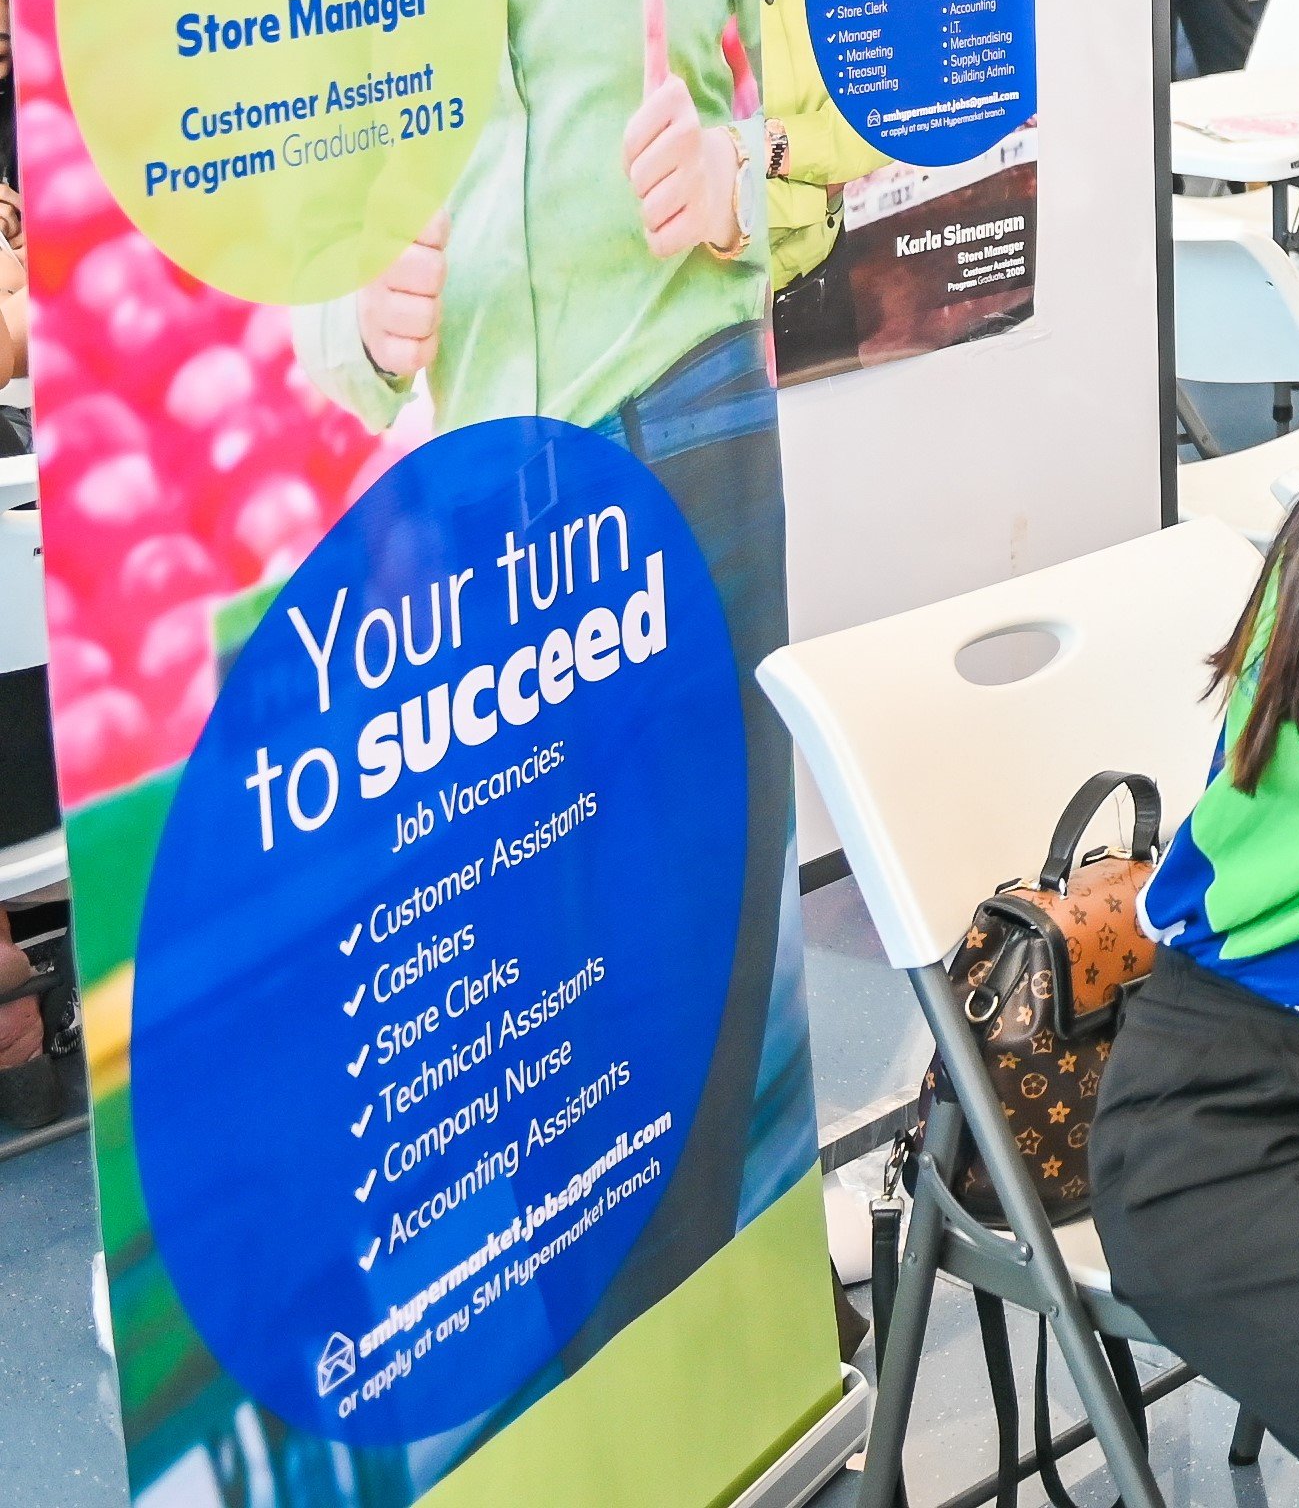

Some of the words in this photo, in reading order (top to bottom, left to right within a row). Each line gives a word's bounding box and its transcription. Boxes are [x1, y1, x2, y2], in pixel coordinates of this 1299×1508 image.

[175, 7, 279, 57] Store
[837, 4, 862, 20] Store
[864, 0, 888, 16] Clerk
[838, 27, 882, 45] Manager
[950, 0, 997, 16] Accounting
[950, 30, 1012, 50] Merchandising
[846, 45, 893, 63] Marketing
[847, 63, 887, 79] Treasury
[847, 77, 899, 96] Accounting
[951, 51, 981, 68] Supply
[982, 48, 1006, 63] Chain
[952, 70, 985, 85] Building
[986, 63, 1015, 79] Admin
[180, 95, 319, 141] Customer
[325, 62, 434, 114] Assistant
[144, 147, 276, 196] Program
[282, 118, 396, 168] Graduate,
[399, 97, 466, 141] 2013
[896, 230, 942, 257] Karla
[943, 215, 1025, 246] Simangan
[957, 251, 983, 265] Store
[984, 241, 1025, 261] Manager
[287, 565, 475, 714] Your
[496, 505, 631, 625] turn
[245, 746, 341, 852] to
[356, 549, 668, 800] succeed
[391, 801, 436, 854] Job
[439, 740, 567, 824] Vacancies:
[368, 855, 485, 942] Customer
[490, 791, 598, 878] Assistants
[372, 922, 476, 1005] Cashiers
[376, 1005, 440, 1067] Store
[444, 956, 521, 1019] Clerks
[378, 1022, 493, 1124] Technical
[498, 955, 606, 1049] Assistants
[384, 1089, 499, 1184] Company
[505, 1039, 573, 1103] Nurse
[388, 1141, 521, 1256] Accounting
[525, 1058, 632, 1158] Assistants
[358, 1110, 673, 1359] smhypermarket.jobs@gmail.com
[339, 1391, 359, 1420] or
[361, 1350, 414, 1403] apply
[414, 1331, 433, 1359] at
[435, 1309, 470, 1344] any
[472, 1279, 503, 1316] SM
[504, 1200, 605, 1293] Hypermarket
[606, 1158, 662, 1211] branch
